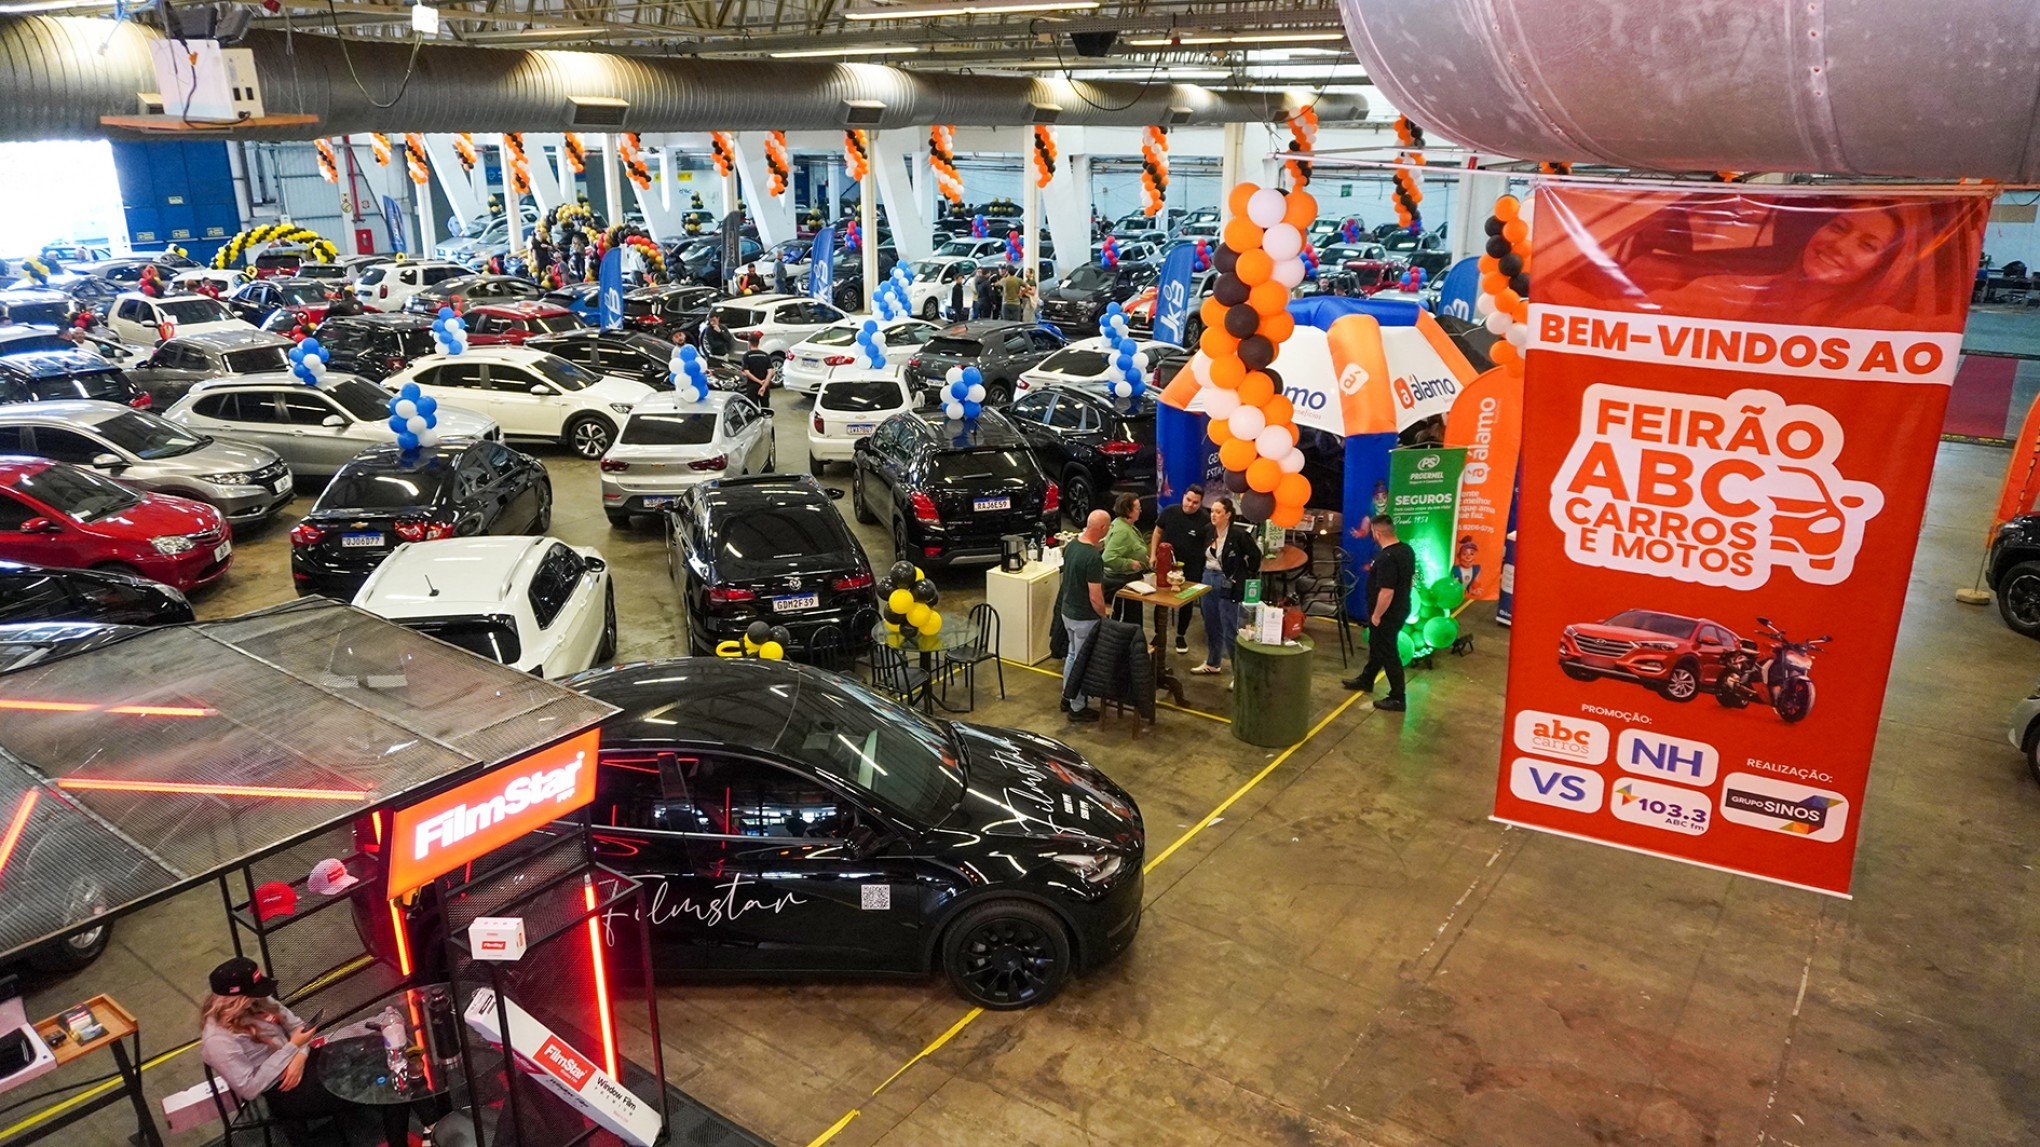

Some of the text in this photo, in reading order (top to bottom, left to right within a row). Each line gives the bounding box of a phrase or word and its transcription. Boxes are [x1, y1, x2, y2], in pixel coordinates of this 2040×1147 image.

[1540, 313, 1943, 375] BEM-VINDOS AO
[1467, 396, 1497, 461] álamo
[1597, 399, 1824, 460] FEIRÃO
[1567, 441, 1767, 519] ABC
[1395, 493, 1453, 506] SEGUROS
[1565, 497, 1757, 552] CARROS
[1580, 527, 1753, 577] E MOTOS
[776, 597, 815, 610] GDM2F39
[1581, 704, 1653, 725] PROMOÇÃO:
[1531, 737, 1591, 755] carros
[1533, 720, 1591, 746] abc
[1631, 738, 1704, 778] NH
[1746, 758, 1834, 784] REALIZAÇÃO:
[1529, 767, 1587, 802] VS
[414, 760, 584, 861] FilmStar
[1638, 797, 1707, 823] 103.3
[1665, 817, 1688, 829] ABC
[1731, 795, 1821, 823] GRUPO SINOS
[544, 1043, 588, 1080] FilmStar
[597, 1076, 622, 1100] Window
[623, 1095, 637, 1111] Film
